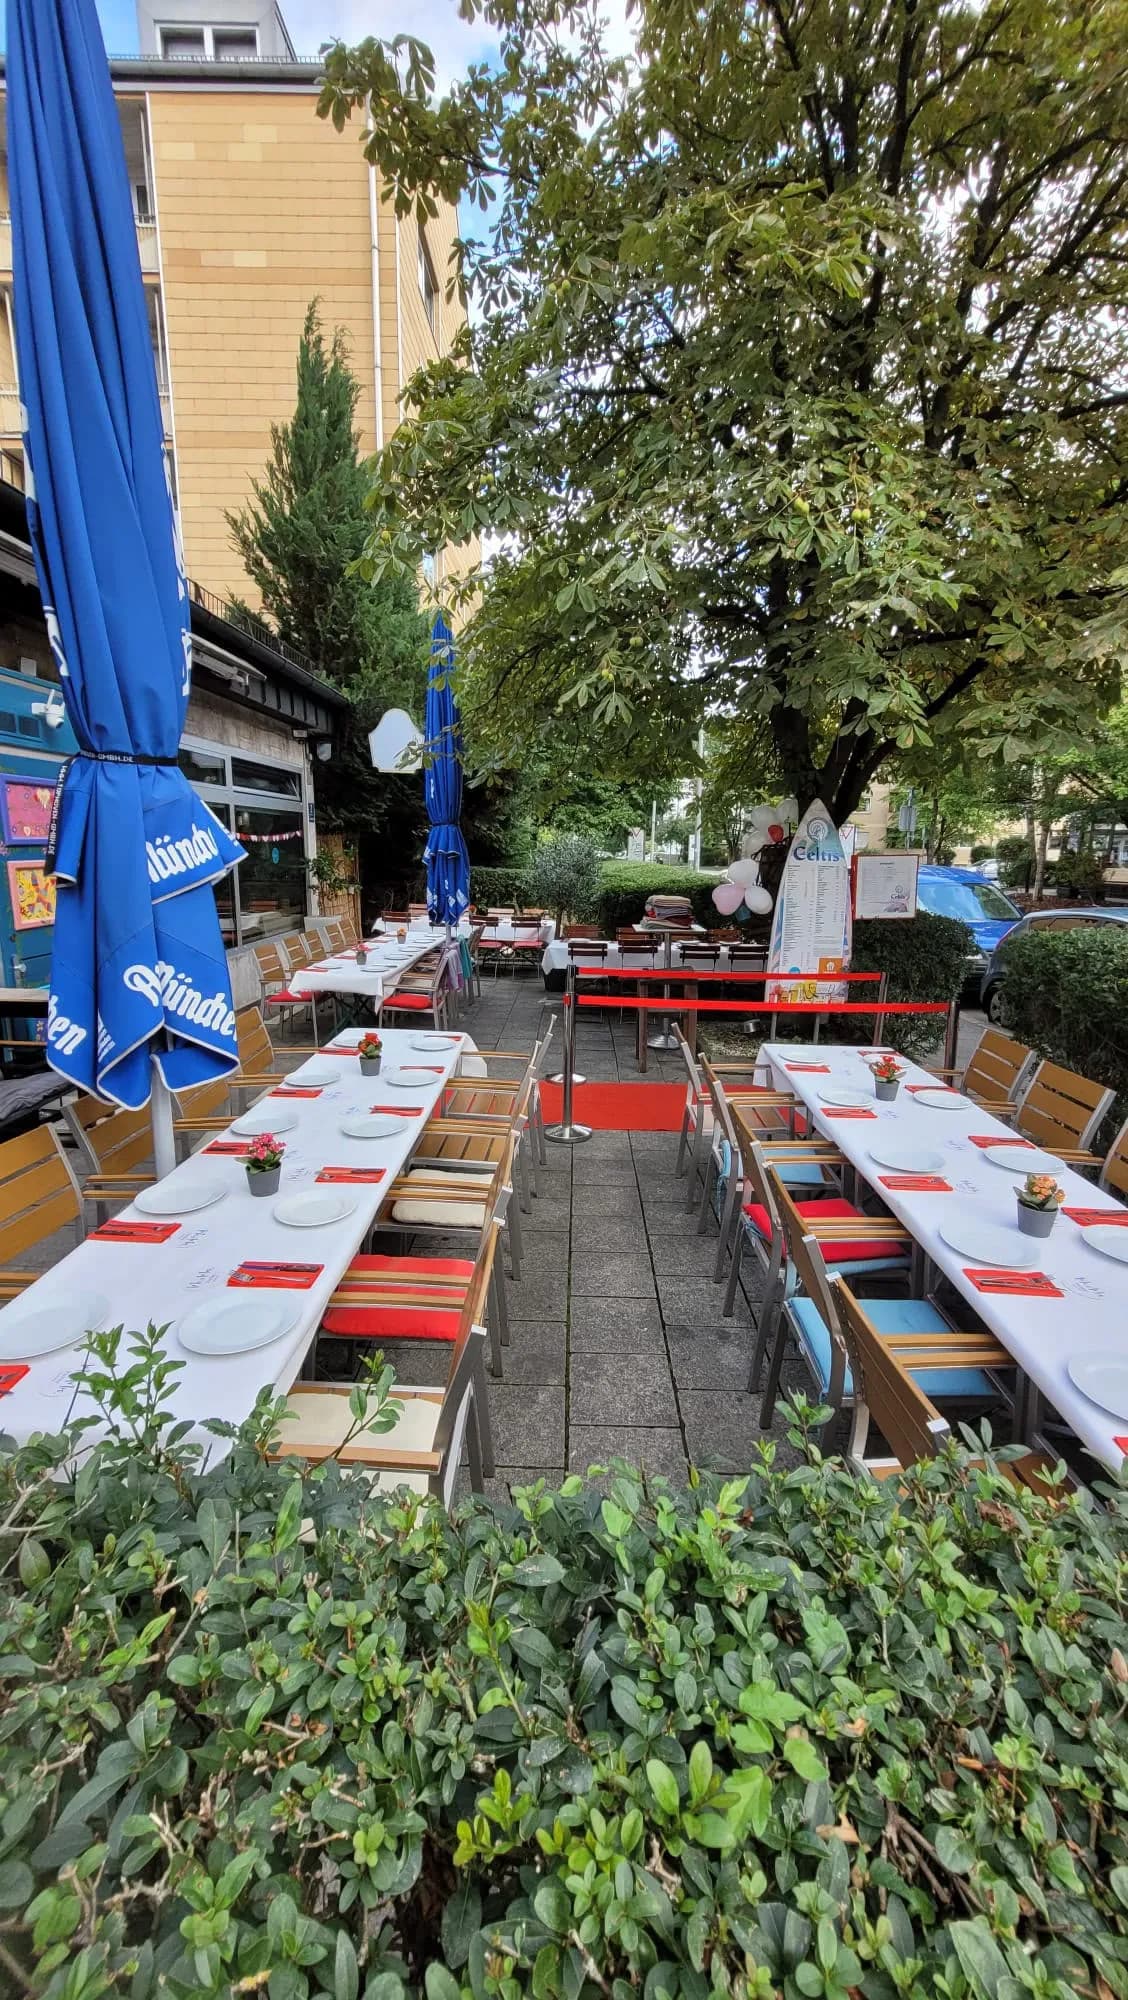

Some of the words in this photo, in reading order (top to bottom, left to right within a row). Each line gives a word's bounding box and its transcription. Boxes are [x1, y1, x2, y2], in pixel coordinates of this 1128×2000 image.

[146, 823, 218, 883] ünch
[793, 846, 840, 861] Celtis
[123, 960, 236, 1041] Münche
